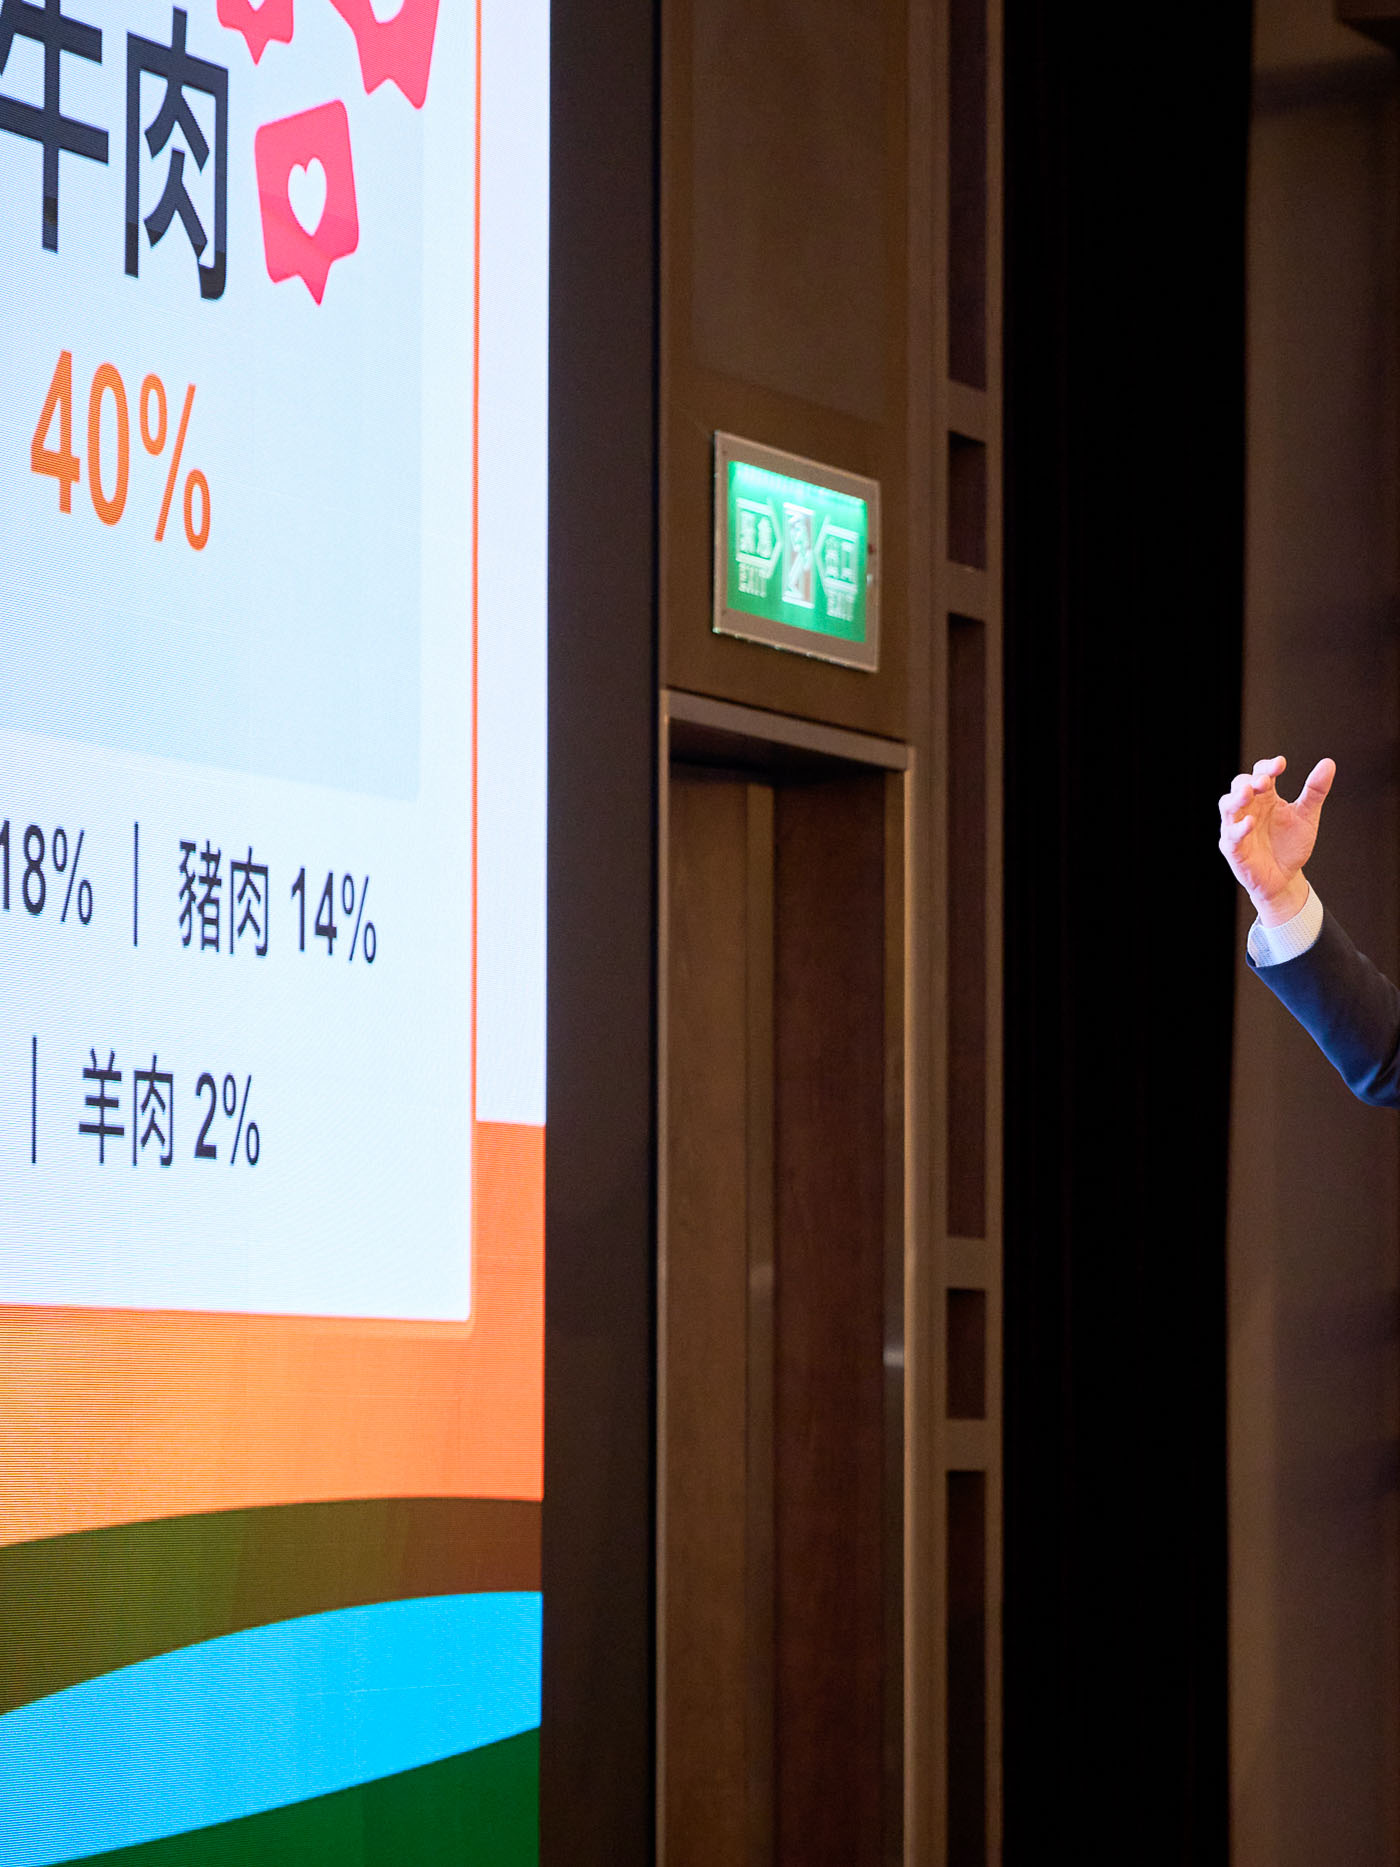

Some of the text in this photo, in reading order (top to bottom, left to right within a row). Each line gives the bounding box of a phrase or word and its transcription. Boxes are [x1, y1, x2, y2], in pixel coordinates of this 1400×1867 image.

[0, 0, 229, 301] 牛肉
[30, 349, 212, 552] 40%
[0, 819, 377, 964] 18% 豬肉 14%
[78, 1046, 261, 1167] 羊肉 2%
